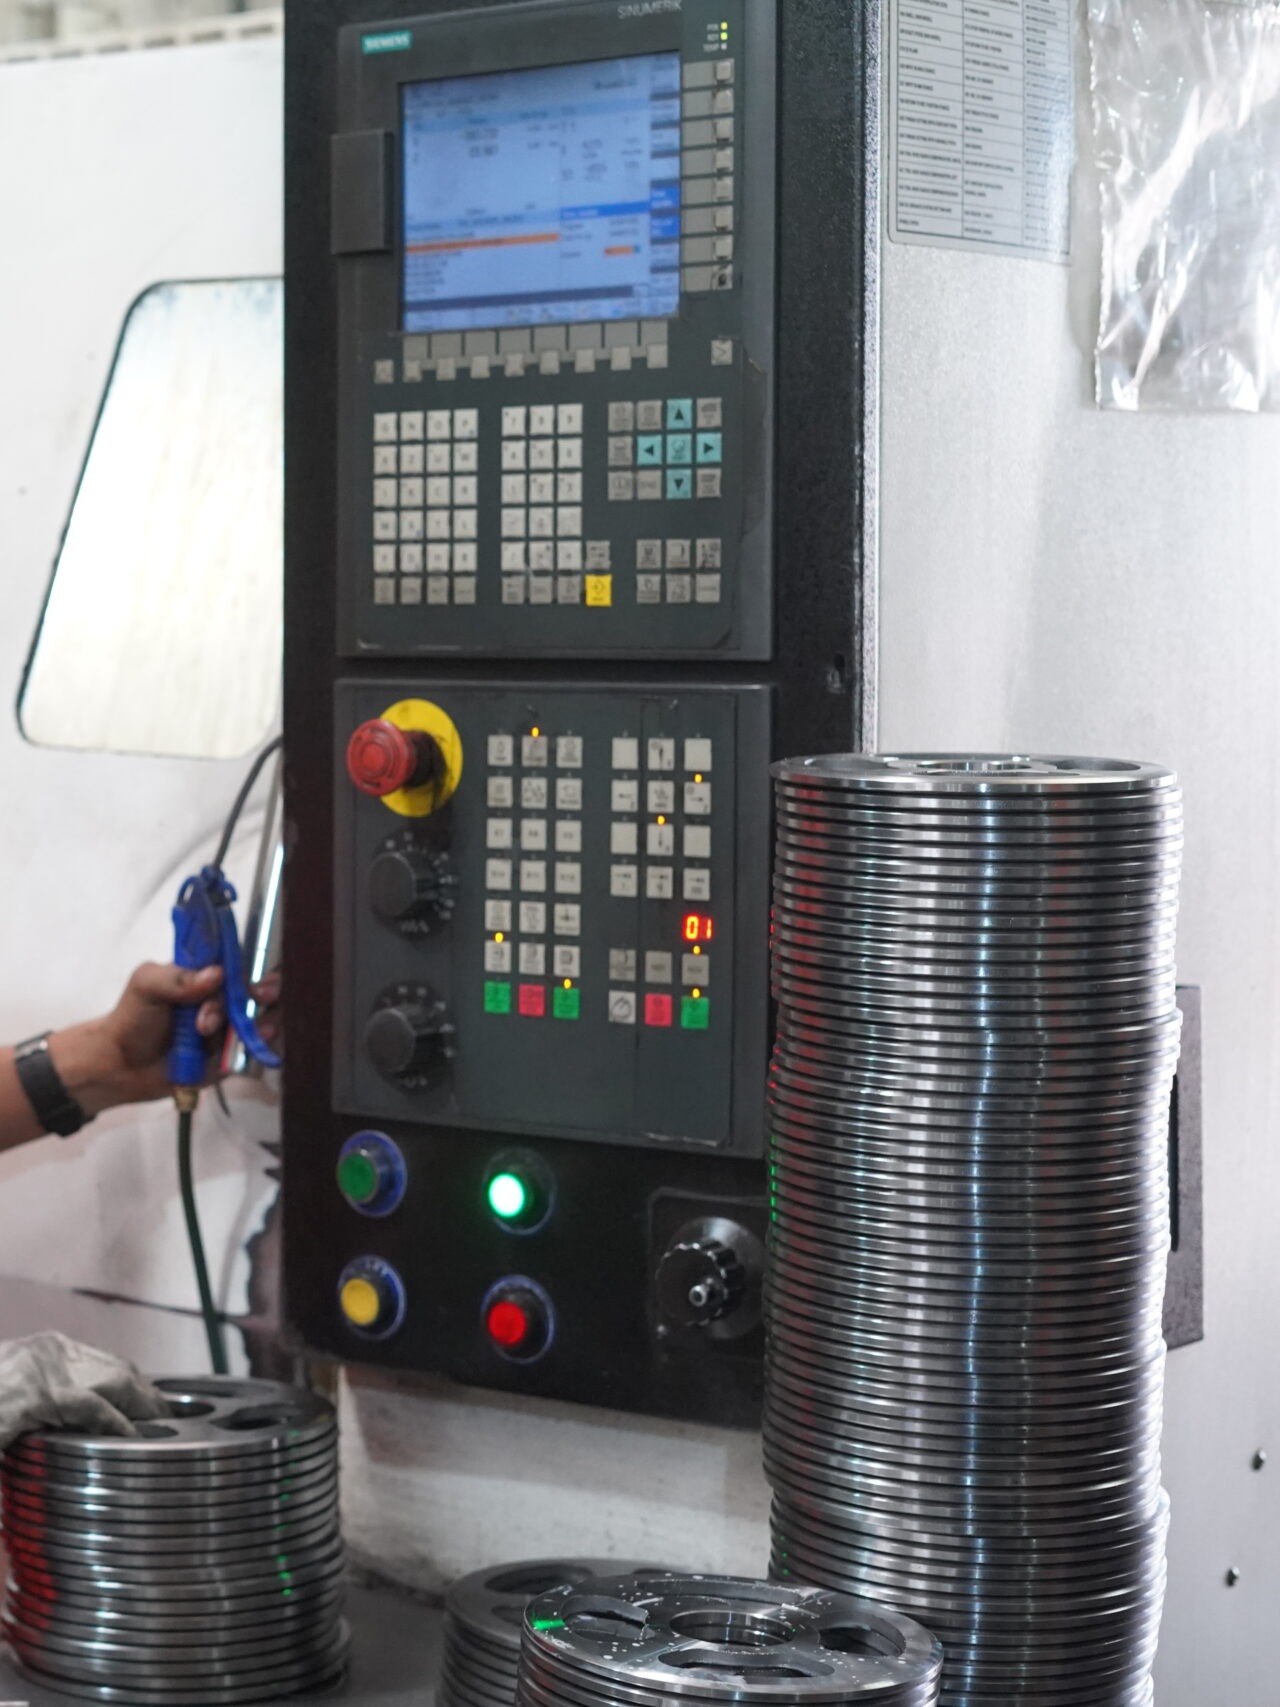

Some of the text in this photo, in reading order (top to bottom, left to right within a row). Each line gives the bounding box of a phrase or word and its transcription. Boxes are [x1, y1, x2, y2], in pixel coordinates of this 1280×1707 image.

[618, 0, 681, 18] SINUMERIK
[365, 34, 410, 50] SIEMENS
[684, 914, 713, 940] 01
